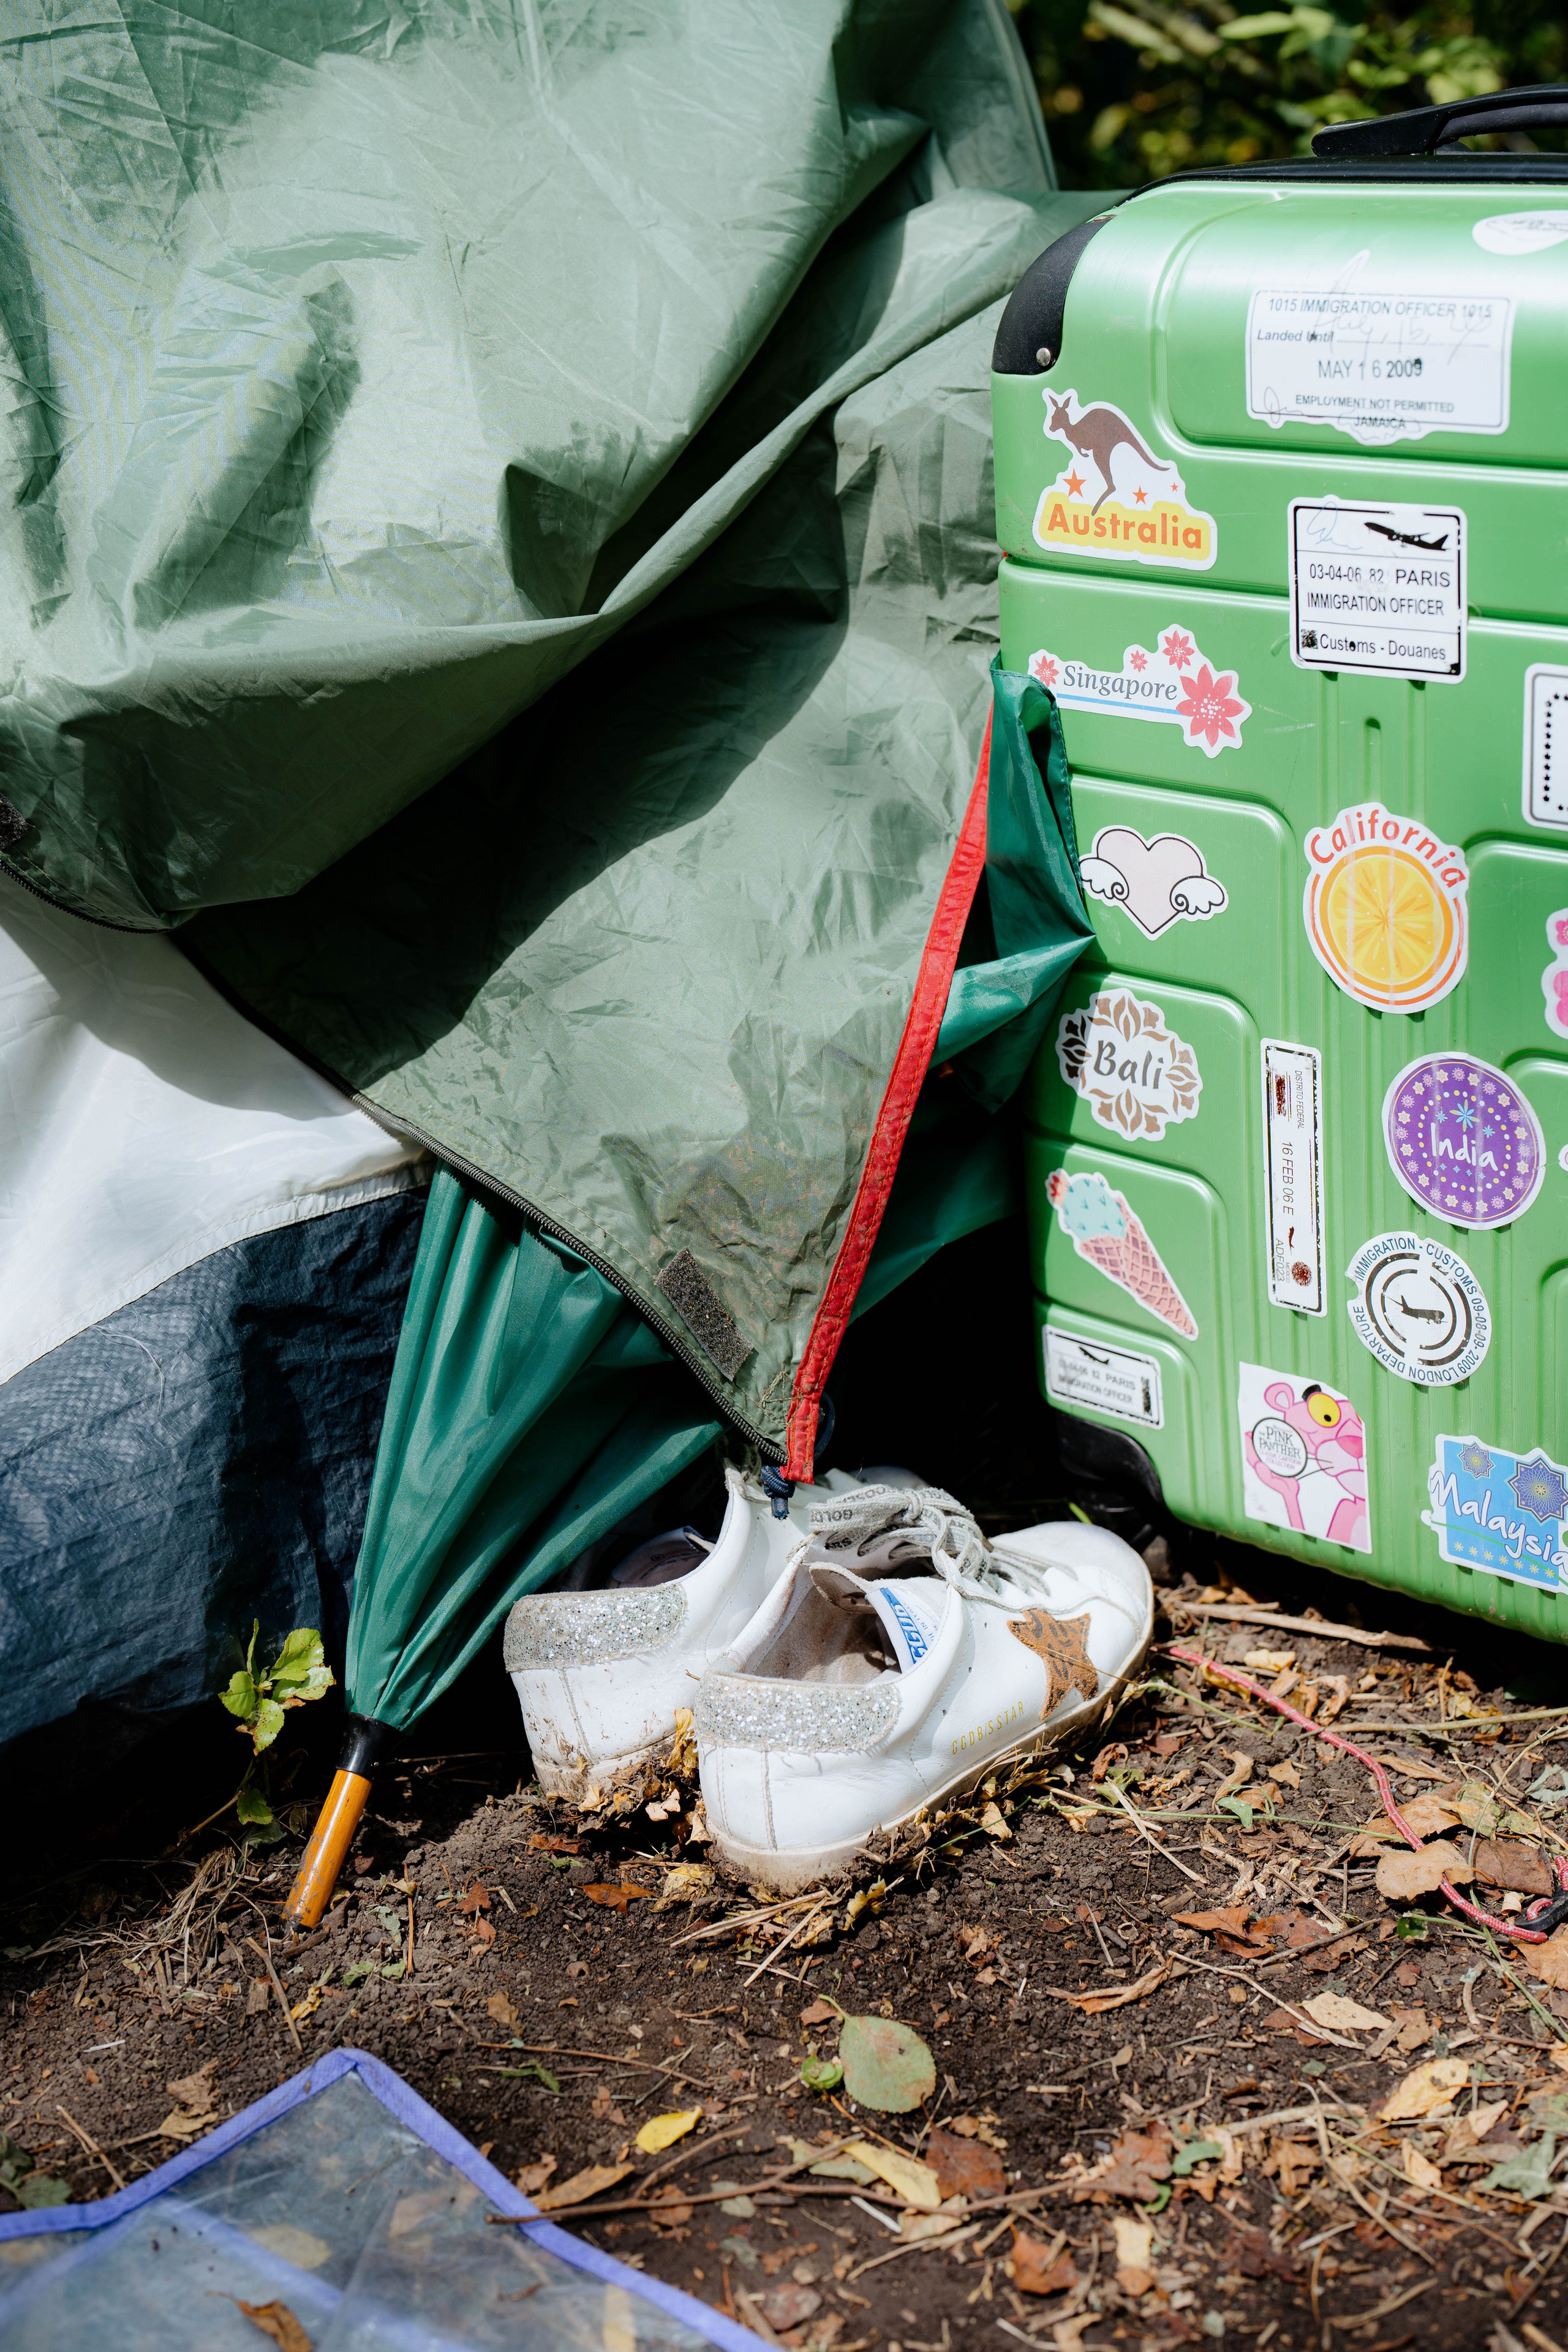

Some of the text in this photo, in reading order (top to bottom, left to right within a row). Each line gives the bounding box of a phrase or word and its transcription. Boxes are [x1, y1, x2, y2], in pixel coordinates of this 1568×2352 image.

[1268, 298, 1492, 318] 1015 IMMIGRATION OFFICER 1015
[1257, 329, 1334, 343] Landed Until
[1318, 360, 1353, 379] MAY
[1387, 358, 1423, 378] 2009
[1295, 394, 1455, 413] EMPLOYMENT NOT PERMITTED
[1354, 417, 1406, 429] JAMAICA
[1047, 503, 1202, 549] Australia
[1310, 564, 1450, 587] 03-04-06 82 PARIS
[1307, 592, 1444, 616] IMMIGRATION OFFICER
[1320, 634, 1376, 654] Customs
[1389, 640, 1446, 660] Douanes
[1063, 665, 1178, 701] Singapore
[1310, 809, 1466, 888] California
[1093, 1040, 1164, 1090] Bali
[1295, 1070, 1305, 1129] DISTRITO FEDERAL
[1430, 1122, 1499, 1172] India
[1282, 1142, 1294, 1216] 16 FEB 06 E
[1276, 1238, 1285, 1282] ADF023
[1354, 1237, 1416, 1281] IMMIGRATION
[1426, 1243, 1477, 1295] CUSTOMS
[1353, 1305, 1406, 1374] DEPARTURE
[1408, 1366, 1460, 1383] LONDON
[1259, 1437, 1302, 1459] PANTHER
[1266, 1426, 1293, 1446] PINK
